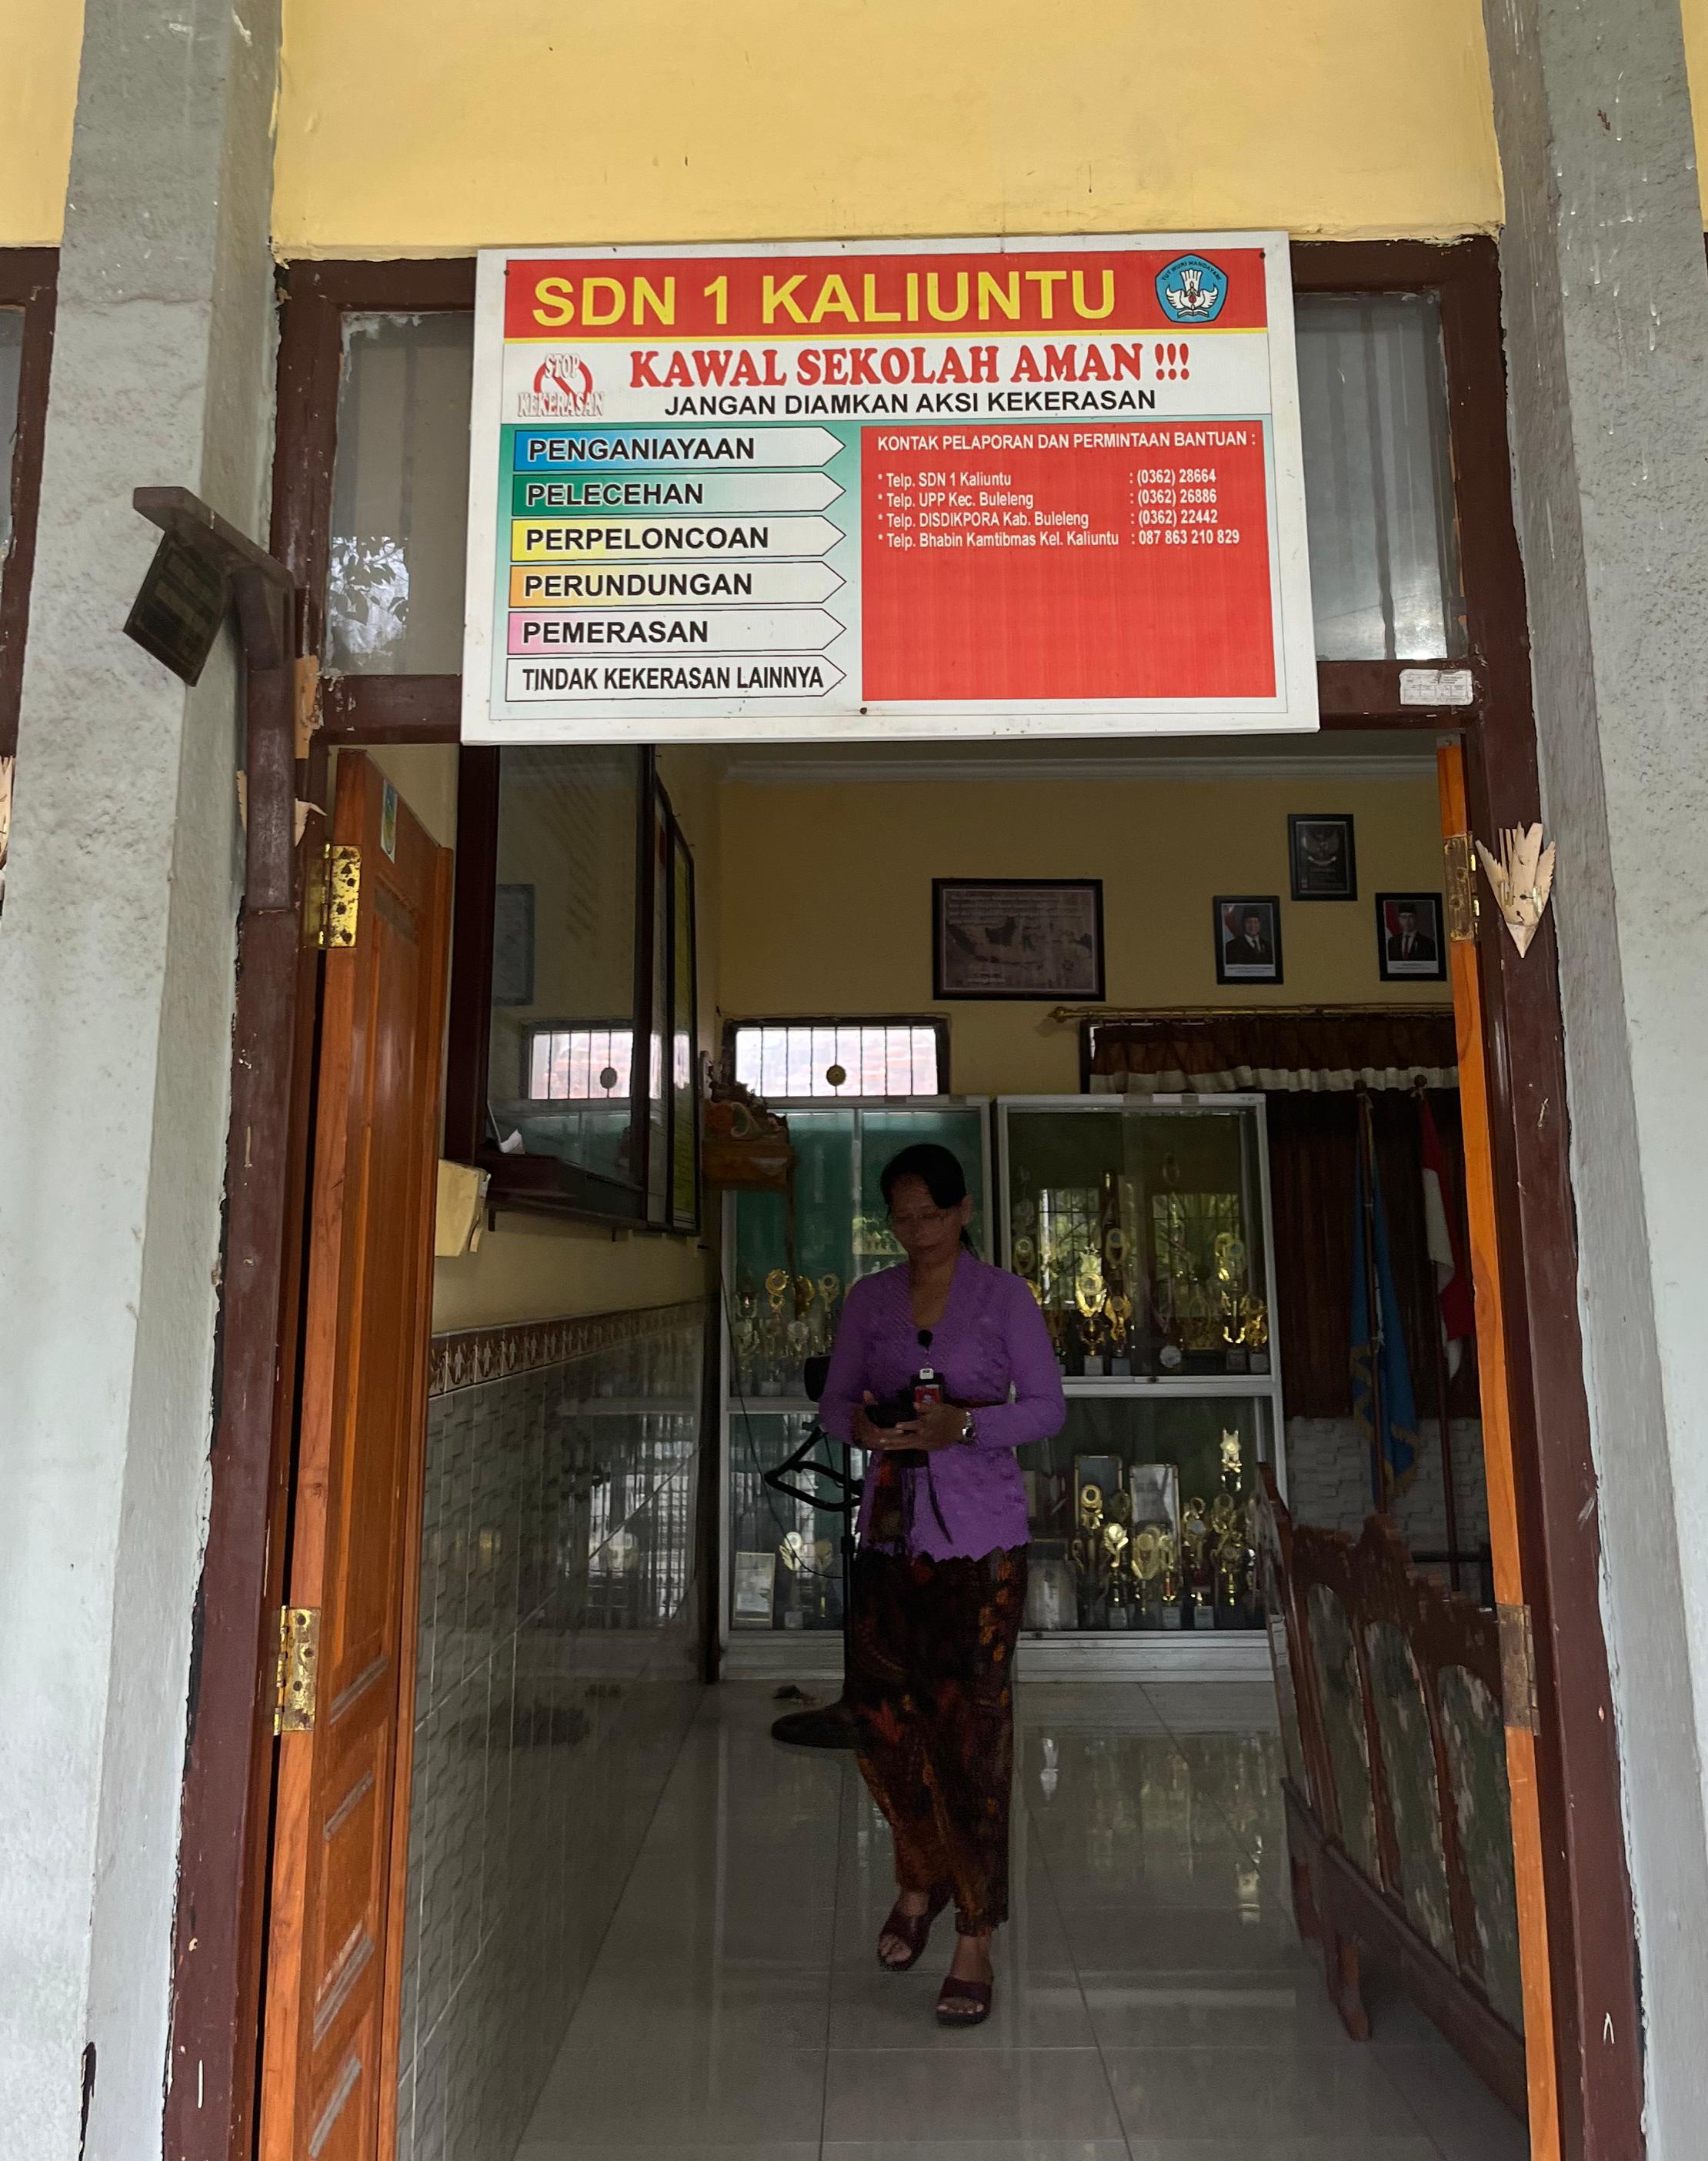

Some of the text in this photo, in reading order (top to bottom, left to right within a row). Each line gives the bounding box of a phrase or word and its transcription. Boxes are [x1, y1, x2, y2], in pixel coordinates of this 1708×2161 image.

[532, 270, 1115, 326] SDN 1 KALIUNTU
[545, 353, 581, 379] STOP
[629, 349, 787, 388] KAWAL
[797, 346, 999, 386] SEKOLAH
[1010, 342, 1143, 383] AMAN
[518, 392, 604, 418] KEKERASAN
[665, 389, 1156, 416] JANGAN DIAMKAN AKSI KEKERASAN
[528, 437, 755, 462] PENGANIAYAAN
[878, 436, 939, 451] KONTAK
[942, 434, 1033, 450] PELAPORAN
[1038, 434, 1069, 449] DAN
[1073, 433, 1170, 448] PERMINTAAN
[1174, 431, 1246, 446] BANTUAN
[886, 473, 916, 490] Telp.
[919, 473, 946, 486] SDN
[949, 472, 956, 486] 1
[960, 472, 1011, 486] Kaliuntu
[1137, 469, 1176, 486] (0362)
[1179, 469, 1216, 483] 28664
[527, 483, 703, 506] PELECEHAN
[886, 493, 916, 509] Telp.
[919, 493, 946, 506] UPP
[949, 493, 976, 506] Kec.
[979, 492, 1033, 509] Buleleng
[1138, 489, 1176, 506] (0362)
[1179, 489, 1217, 503] 26886
[886, 513, 916, 530] Telp.
[919, 512, 999, 527] DISDIKPORA
[1003, 512, 1031, 526] Kab.
[1035, 511, 1089, 529] Buleleng
[1139, 509, 1177, 526] (0362)
[1181, 509, 1217, 524] 22442
[525, 526, 769, 551] PERPELONCOAN
[886, 533, 916, 550] Telp.
[919, 533, 962, 547] Bhabin
[966, 532, 1036, 547] Kamtibmas
[1039, 532, 1062, 546] Kel.
[1067, 531, 1119, 545] Kaliuntu
[1139, 530, 1160, 545] 087
[1165, 530, 1187, 544] 863
[1191, 529, 1213, 544] 210
[1217, 529, 1239, 544] 829
[524, 573, 752, 597] PERUNDUNGAN
[522, 620, 708, 644] PEMERASAN
[522, 666, 824, 691] TINDAK KEKERASAN LAINNYA
